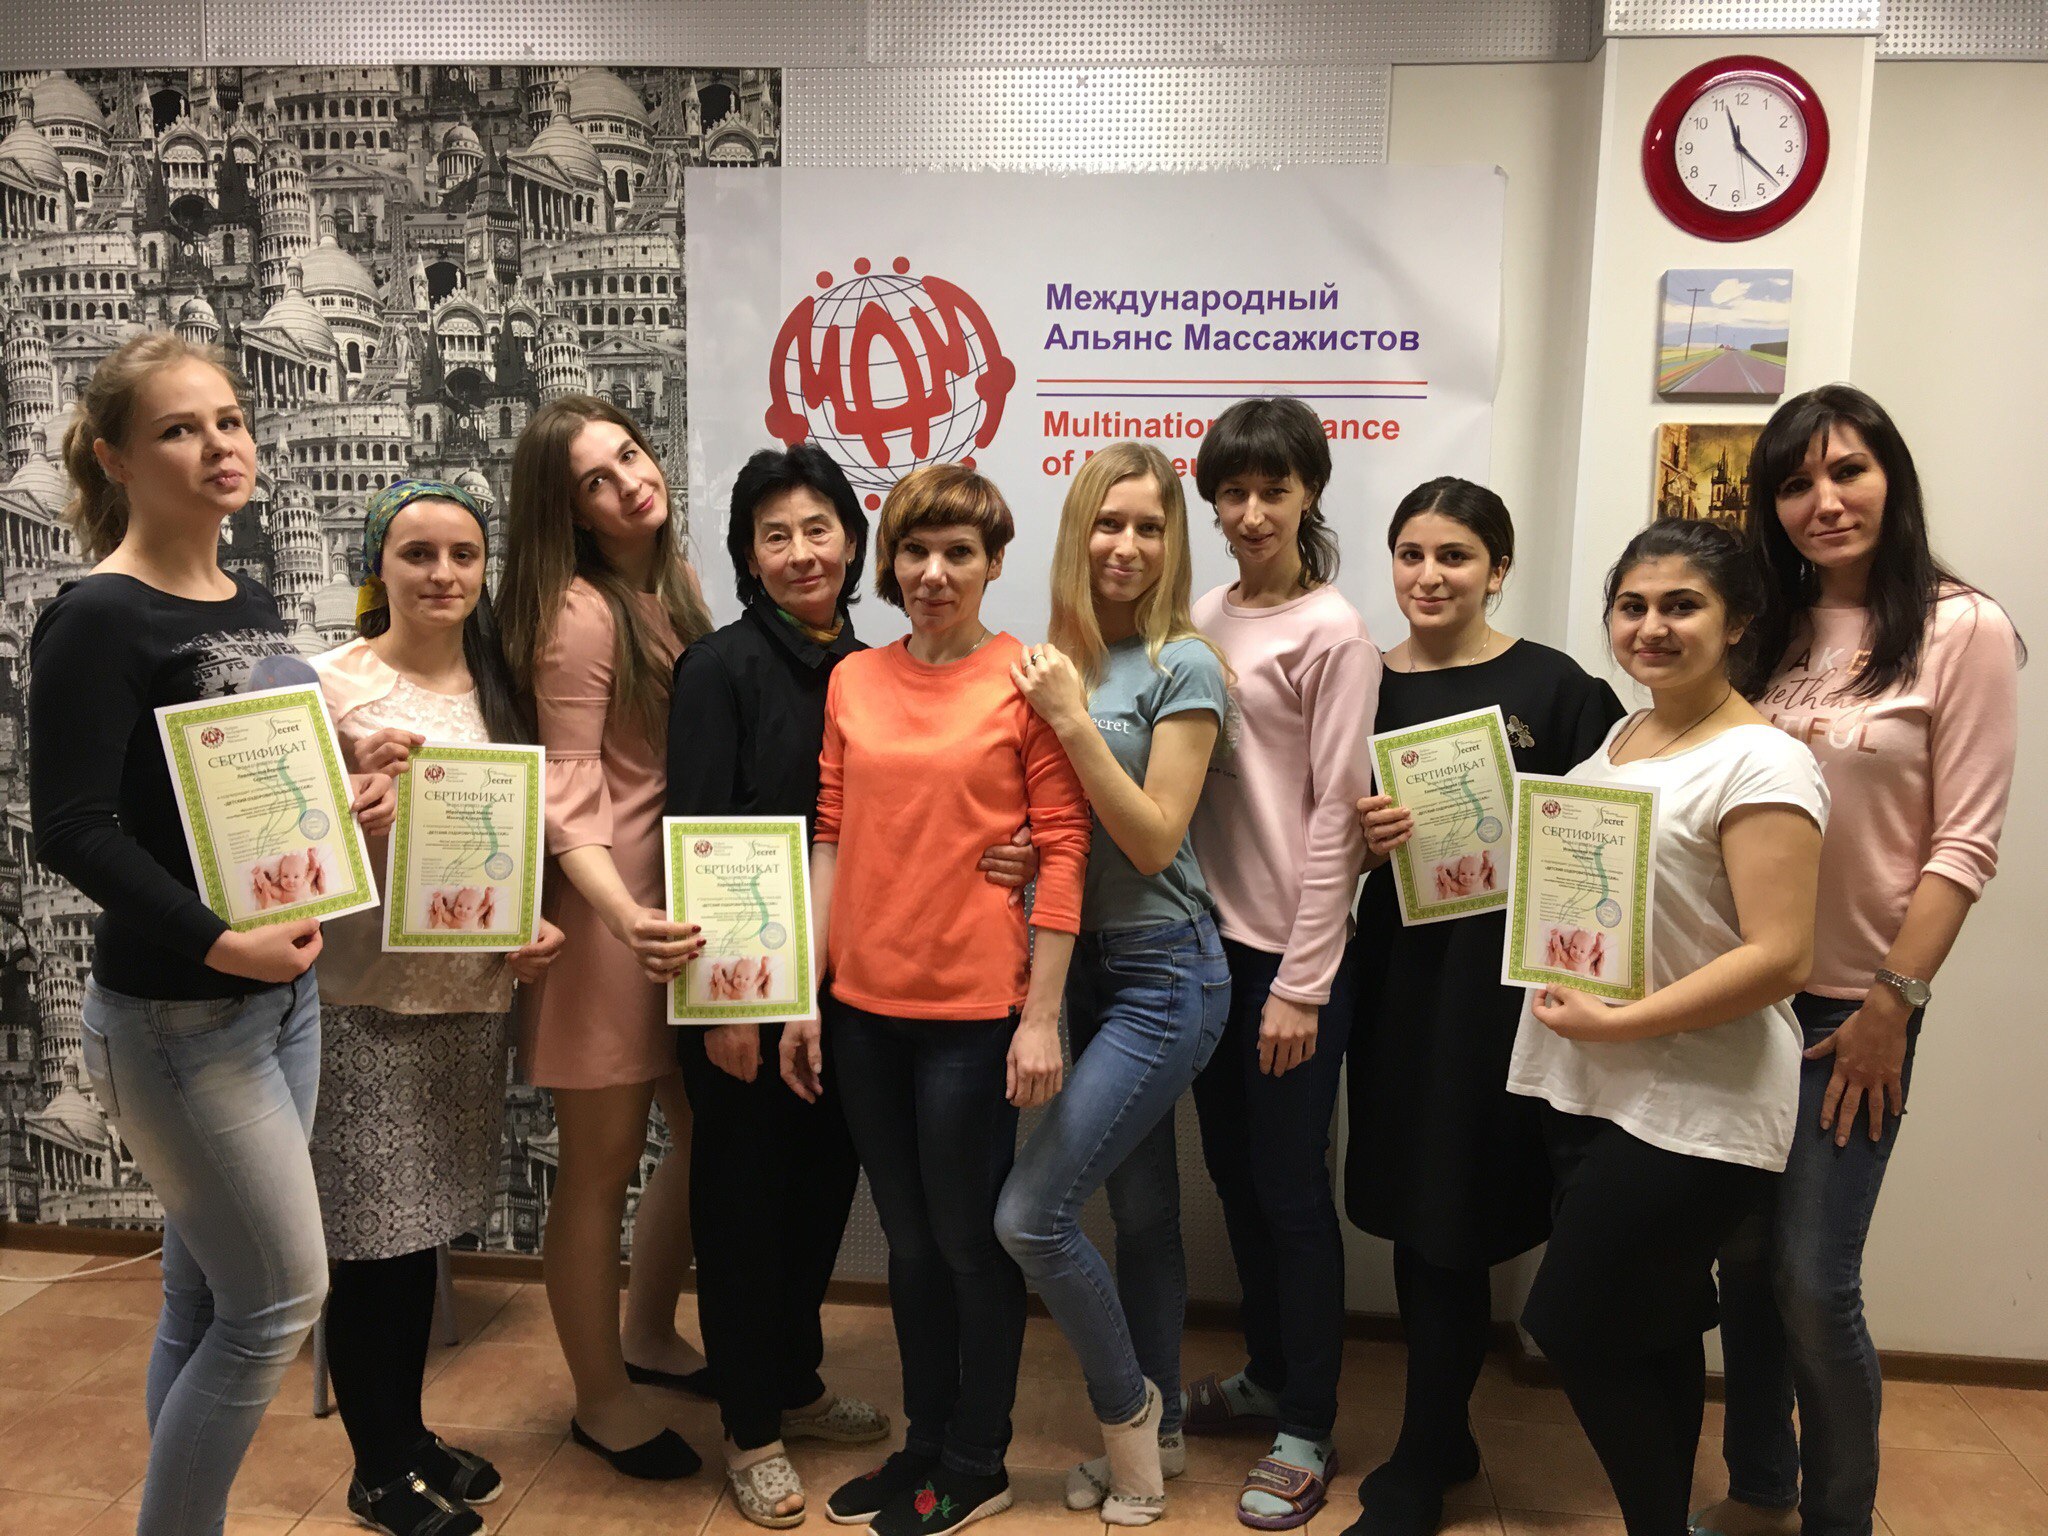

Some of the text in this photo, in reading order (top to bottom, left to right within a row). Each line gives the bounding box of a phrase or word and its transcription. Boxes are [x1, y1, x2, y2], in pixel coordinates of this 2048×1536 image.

[1712, 98, 1725, 112] 11
[1735, 92, 1749, 106] 12
[1762, 98, 1768, 110] 1
[1693, 117, 1709, 130] 10
[1779, 115, 1789, 129] 2
[1684, 141, 1694, 155] 9
[1784, 139, 1793, 153] 3
[1689, 165, 1699, 179] 8
[1776, 164, 1785, 176] 4
[1708, 184, 1718, 197] 7
[1756, 183, 1766, 195] 5
[1731, 190, 1740, 203] 6
[1045, 281, 1339, 318] Международный
[1043, 323, 1420, 351] Альянс Массажистов
[1042, 449, 1074, 476] of
[1788, 647, 1872, 676] AKE
[207, 740, 307, 769] СЕРТИФИКАТ
[1405, 758, 1486, 785] СЕРТИФИКАТ
[424, 791, 515, 803] СЕРТИФИКАТ
[1541, 825, 1626, 846] СЕРТИФИКАТ
[695, 863, 780, 875] СЕРТИФИКАТ
